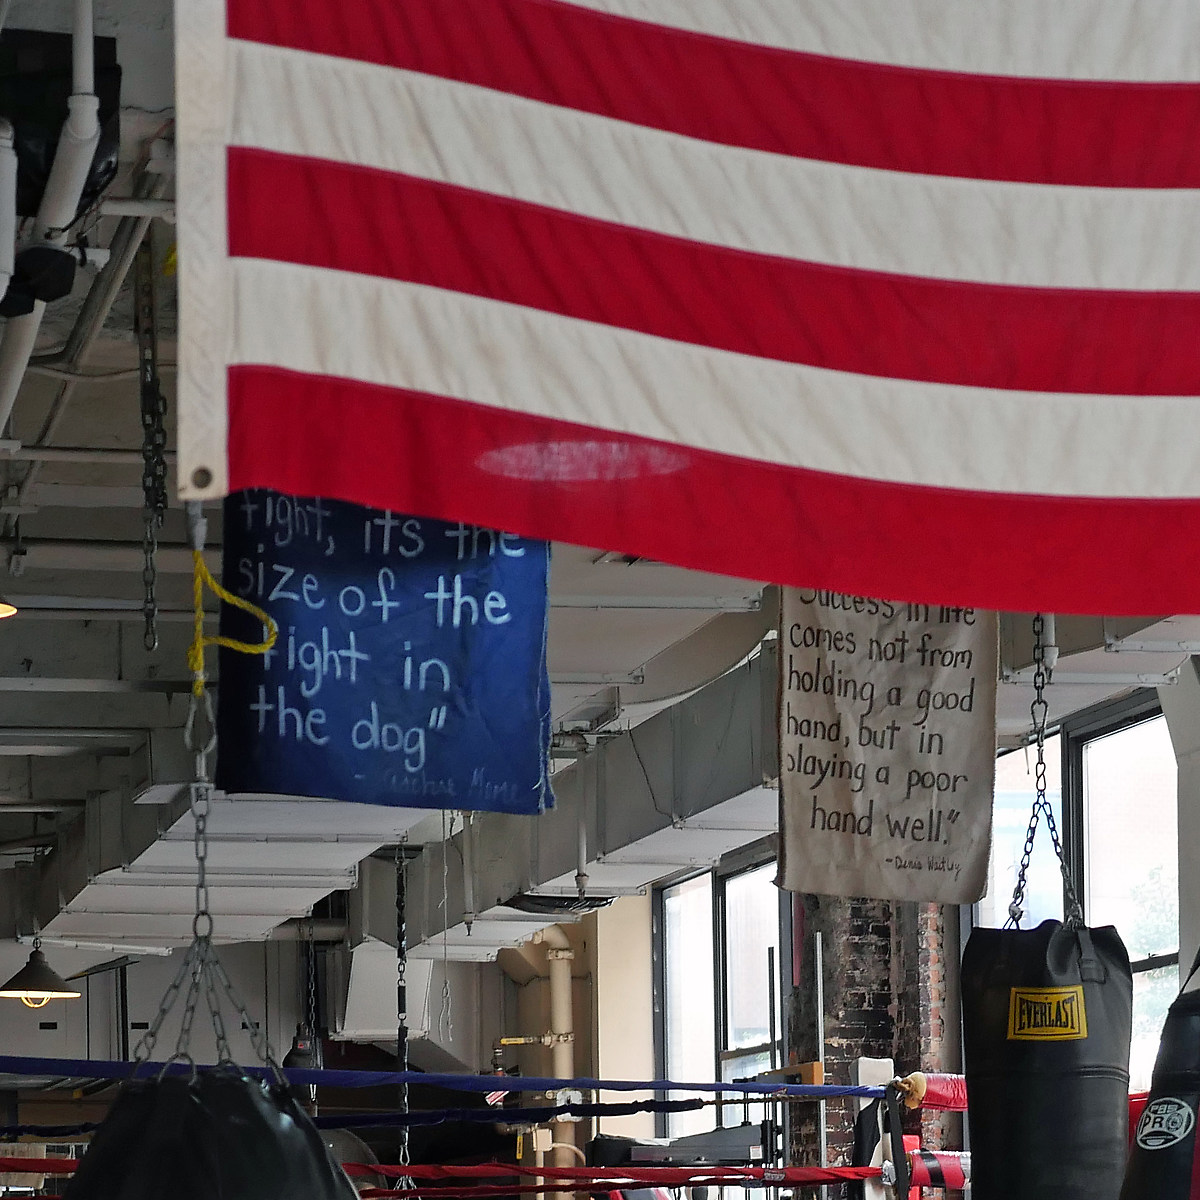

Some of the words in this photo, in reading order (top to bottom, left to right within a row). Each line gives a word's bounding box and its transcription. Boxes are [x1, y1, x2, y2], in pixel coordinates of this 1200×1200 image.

[364, 505, 425, 557] its
[445, 521, 525, 560] the
[238, 543, 325, 609] size
[339, 566, 399, 623] of
[423, 574, 512, 628] the
[260, 618, 370, 698] fight
[402, 640, 451, 692] in
[790, 623, 856, 654] comes
[868, 630, 909, 664] not
[916, 633, 973, 670] from
[249, 684, 330, 746] the
[788, 655, 874, 717] holding
[887, 686, 901, 706] a
[912, 677, 975, 726] good
[786, 702, 850, 748] hand,
[858, 714, 901, 750] but
[918, 723, 944, 755] in
[875, 765, 890, 785] a
[906, 767, 968, 800] poor
[809, 795, 874, 838] hand
[1018, 996, 1075, 1031] EVERLAST
